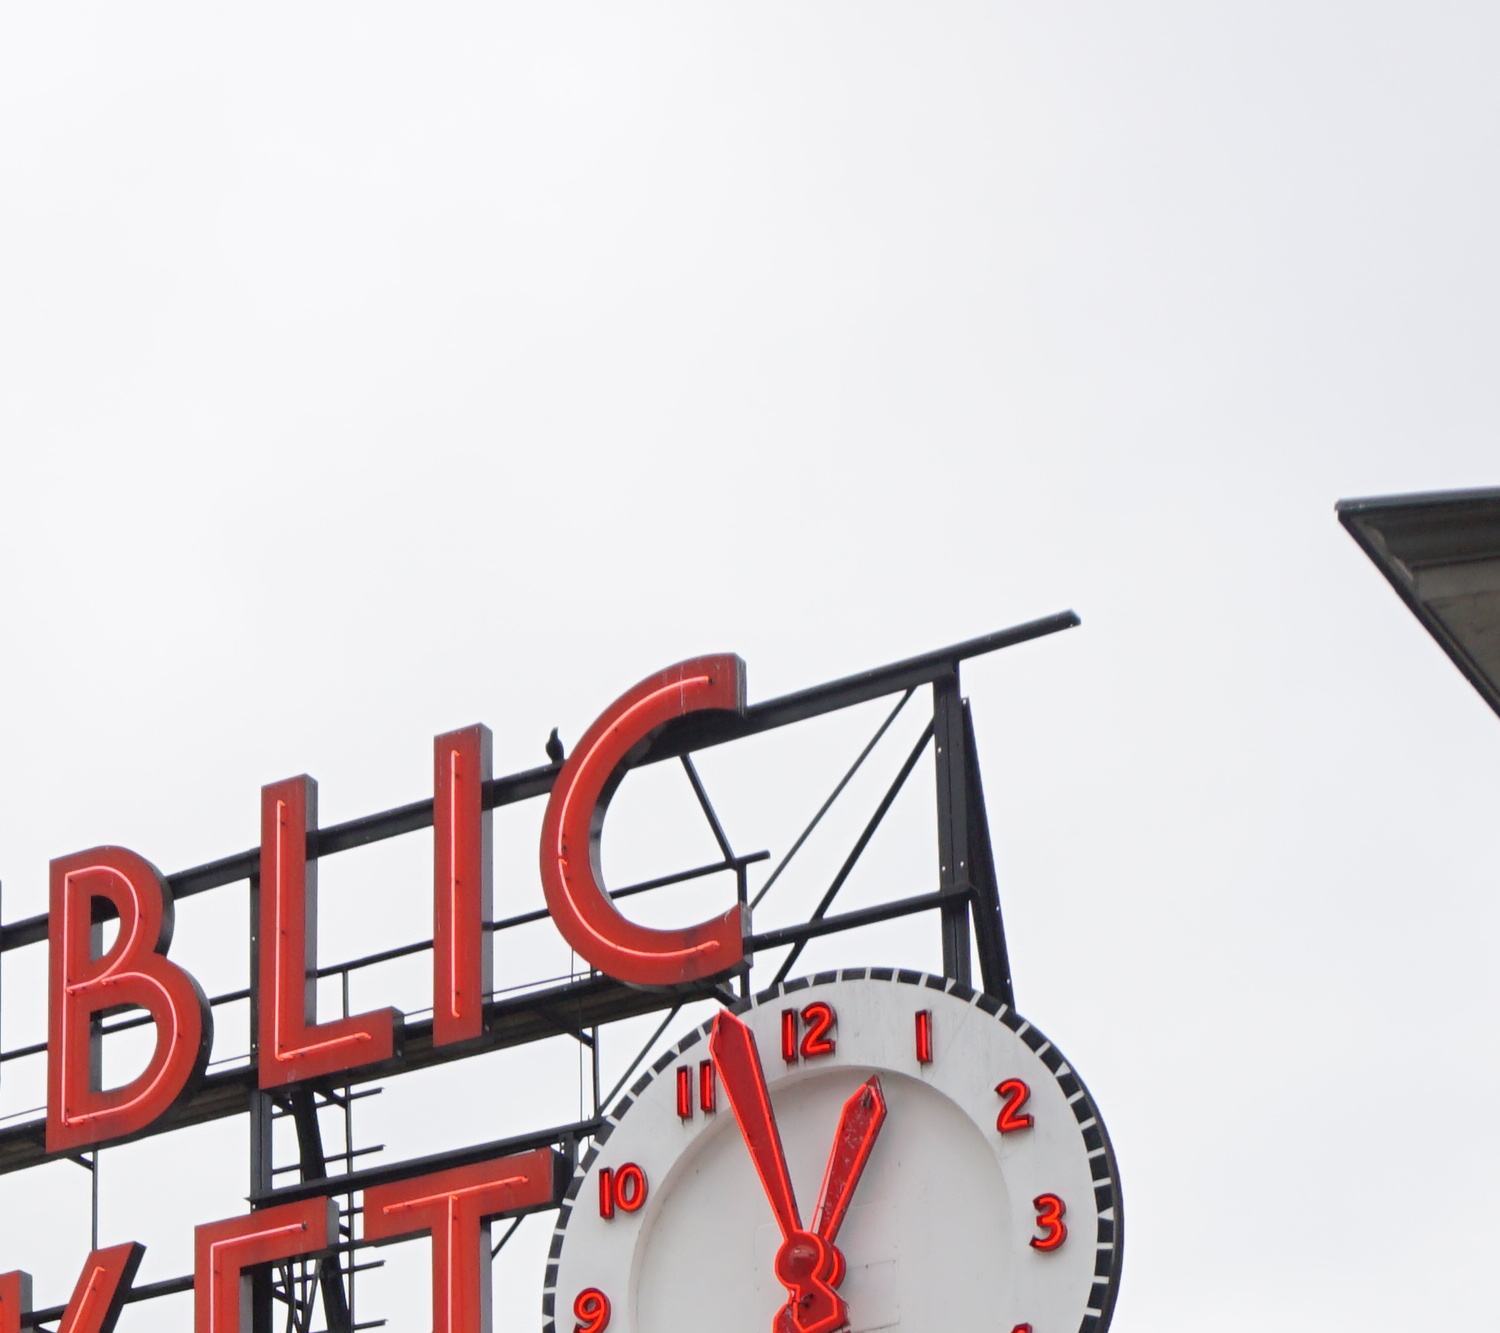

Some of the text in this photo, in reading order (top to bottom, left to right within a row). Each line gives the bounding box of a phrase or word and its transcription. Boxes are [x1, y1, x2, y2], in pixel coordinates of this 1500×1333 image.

[780, 1002, 836, 1062] 12
[915, 1012, 936, 1063] 1
[676, 1062, 716, 1119] 11
[996, 1078, 1036, 1133] 2
[598, 1162, 649, 1221] 10
[1031, 1194, 1071, 1252] 3
